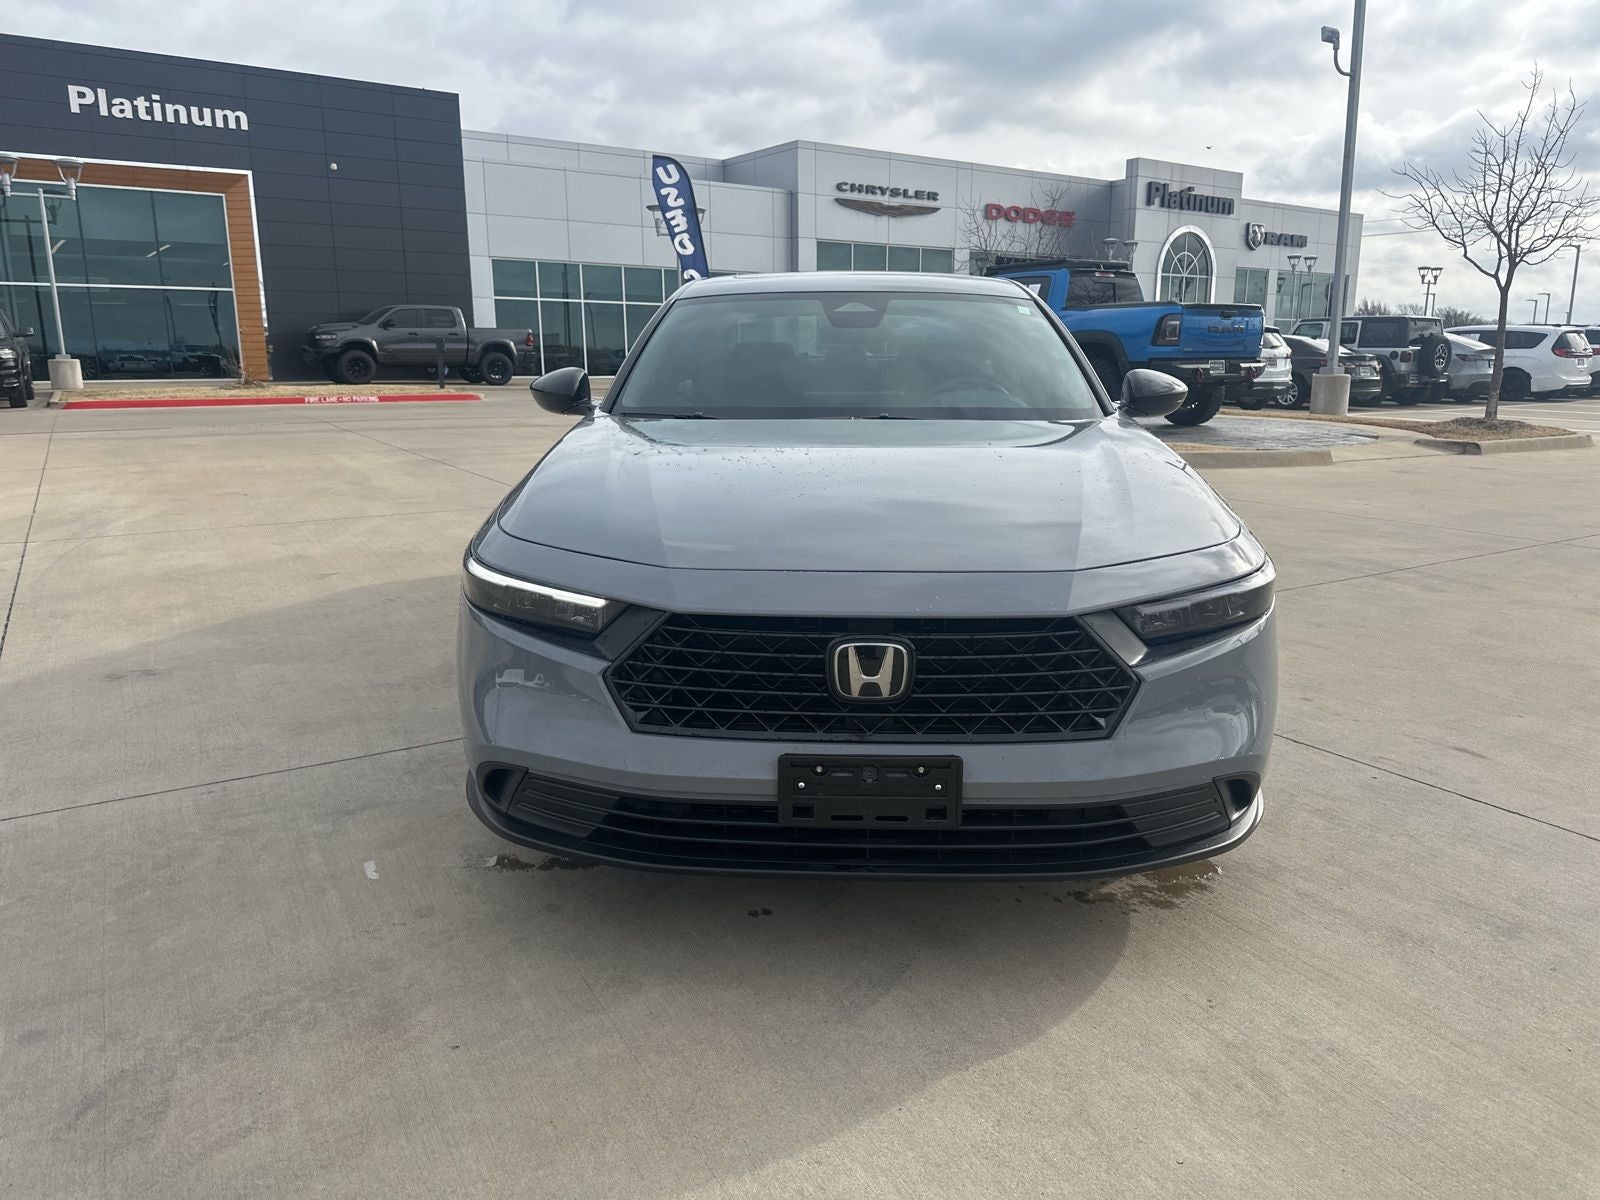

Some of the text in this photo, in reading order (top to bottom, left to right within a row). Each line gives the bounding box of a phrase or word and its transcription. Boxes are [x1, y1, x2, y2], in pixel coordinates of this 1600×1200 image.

[67, 84, 249, 130] Platinum
[836, 182, 939, 201] CHRYSLER
[1146, 181, 1235, 215] Platinum
[984, 203, 1076, 227] DODGE
[1264, 232, 1308, 247] RAM
[1208, 325, 1246, 334] RAM
